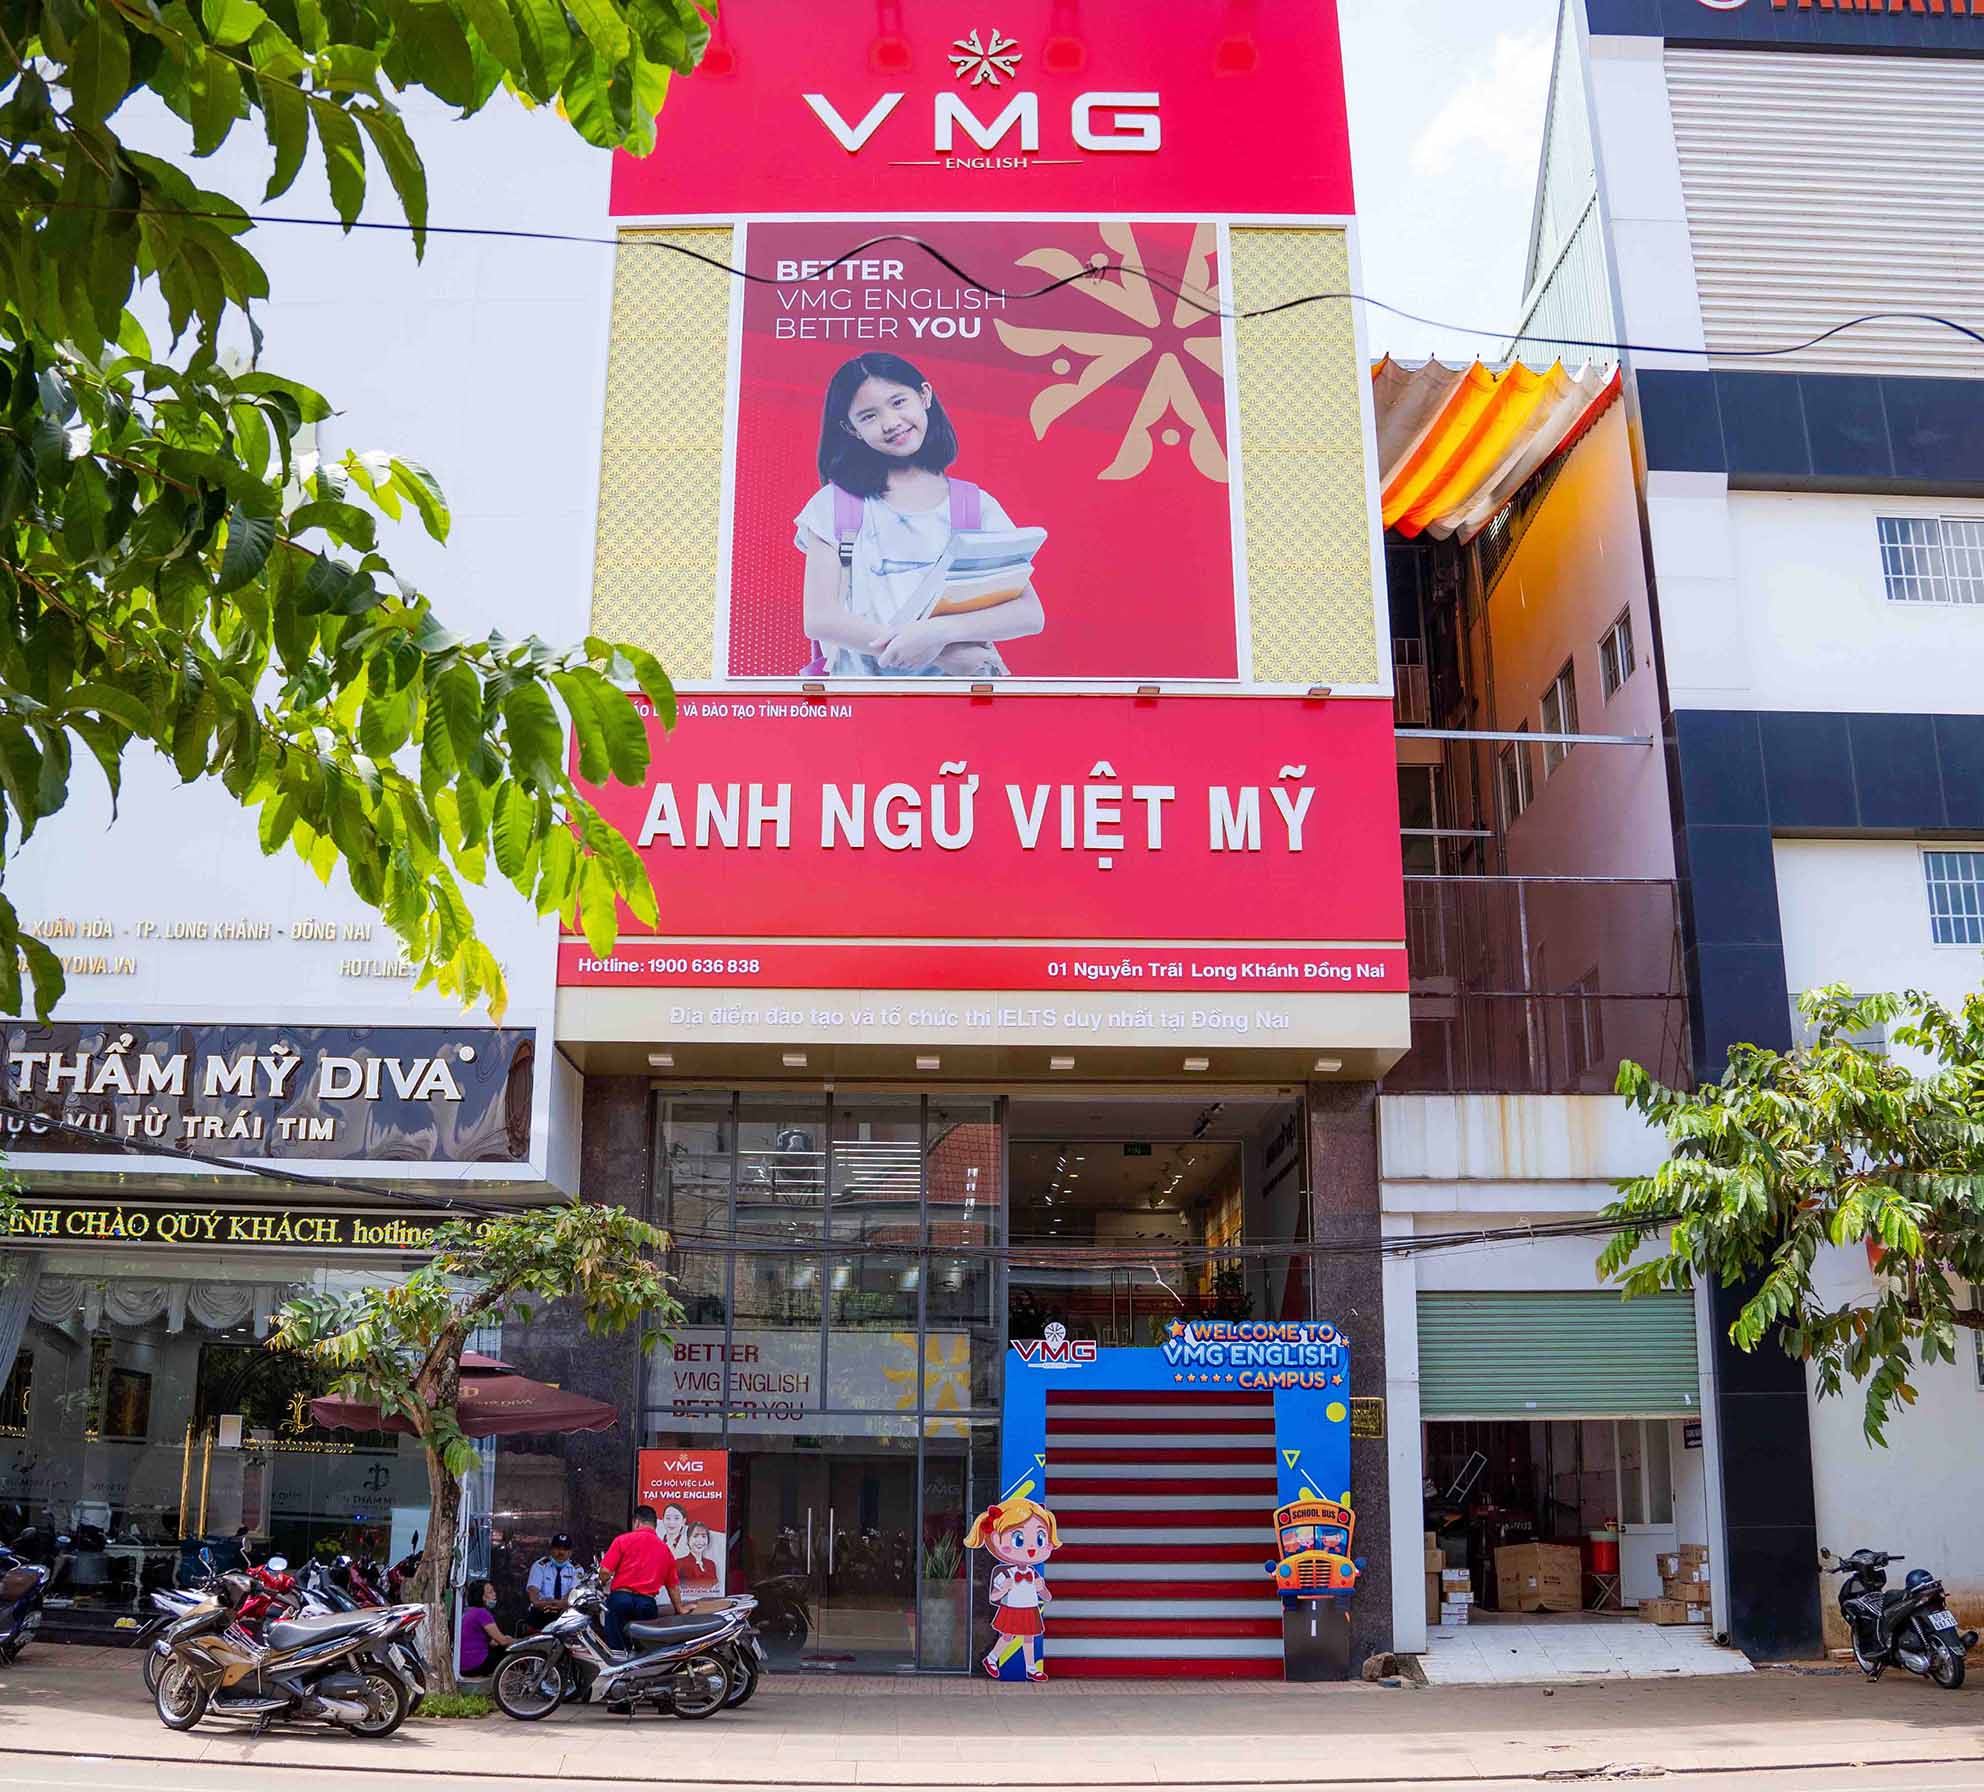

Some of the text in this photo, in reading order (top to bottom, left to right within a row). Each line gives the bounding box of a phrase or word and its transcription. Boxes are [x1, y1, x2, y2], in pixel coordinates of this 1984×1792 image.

[801, 92, 1161, 152] VMG
[945, 157, 1028, 169] ENGLISH
[776, 260, 904, 281] BETTER
[776, 288, 1006, 311] VMG ENGLISH
[775, 317, 981, 339] BETTER YOU
[683, 702, 698, 717] VÀ
[702, 702, 728, 717] ĐÀO
[731, 704, 755, 719] TẠO
[759, 702, 787, 717] TỈNH
[790, 700, 827, 718] ĐỒNG
[831, 705, 852, 718] NAI
[637, 761, 1316, 869] ANH NGỮ VIỆT MỸ
[135, 920, 159, 939] TP.
[165, 921, 208, 940] LONG
[213, 917, 272, 941] KHÁNH
[292, 918, 336, 941] ĐỒNG
[342, 922, 372, 941] NAI
[578, 958, 760, 974] Hotline: 1900 636 838
[1047, 959, 1384, 981] 01 Nguyễn Trãi Long Khánh Đồng Nai
[669, 1002, 1288, 1032] Địa điểm đào tạo và tổ chức thi IELTS duy nhất tại Đồng Nai
[9, 1032, 462, 1100] THẨM MỸ DIVA
[0, 1112, 50, 1139] ỤC
[123, 1107, 169, 1137] TỪ
[183, 1110, 261, 1139] TRÁI
[277, 1117, 335, 1140] TIM
[9, 1204, 61, 1233] ÍNH
[66, 1207, 150, 1237] CHÀO
[157, 1209, 223, 1242] QUÝ
[227, 1211, 343, 1243] KHÁCH.
[1192, 1323, 1335, 1341] WELCOME TO
[673, 1344, 759, 1362] BETTER
[1010, 1340, 1096, 1362] VMG
[1163, 1345, 1338, 1366] VMG ENGLISH
[674, 1371, 809, 1393] VMG ENGLISH
[1238, 1371, 1327, 1388] CAMPUS
[762, 1401, 803, 1420] YOU
[664, 1461, 704, 1472] VMG
[643, 1491, 722, 1500] TẠI VMG ENGLISH
[1292, 1509, 1336, 1519] SCHOOL BUS
